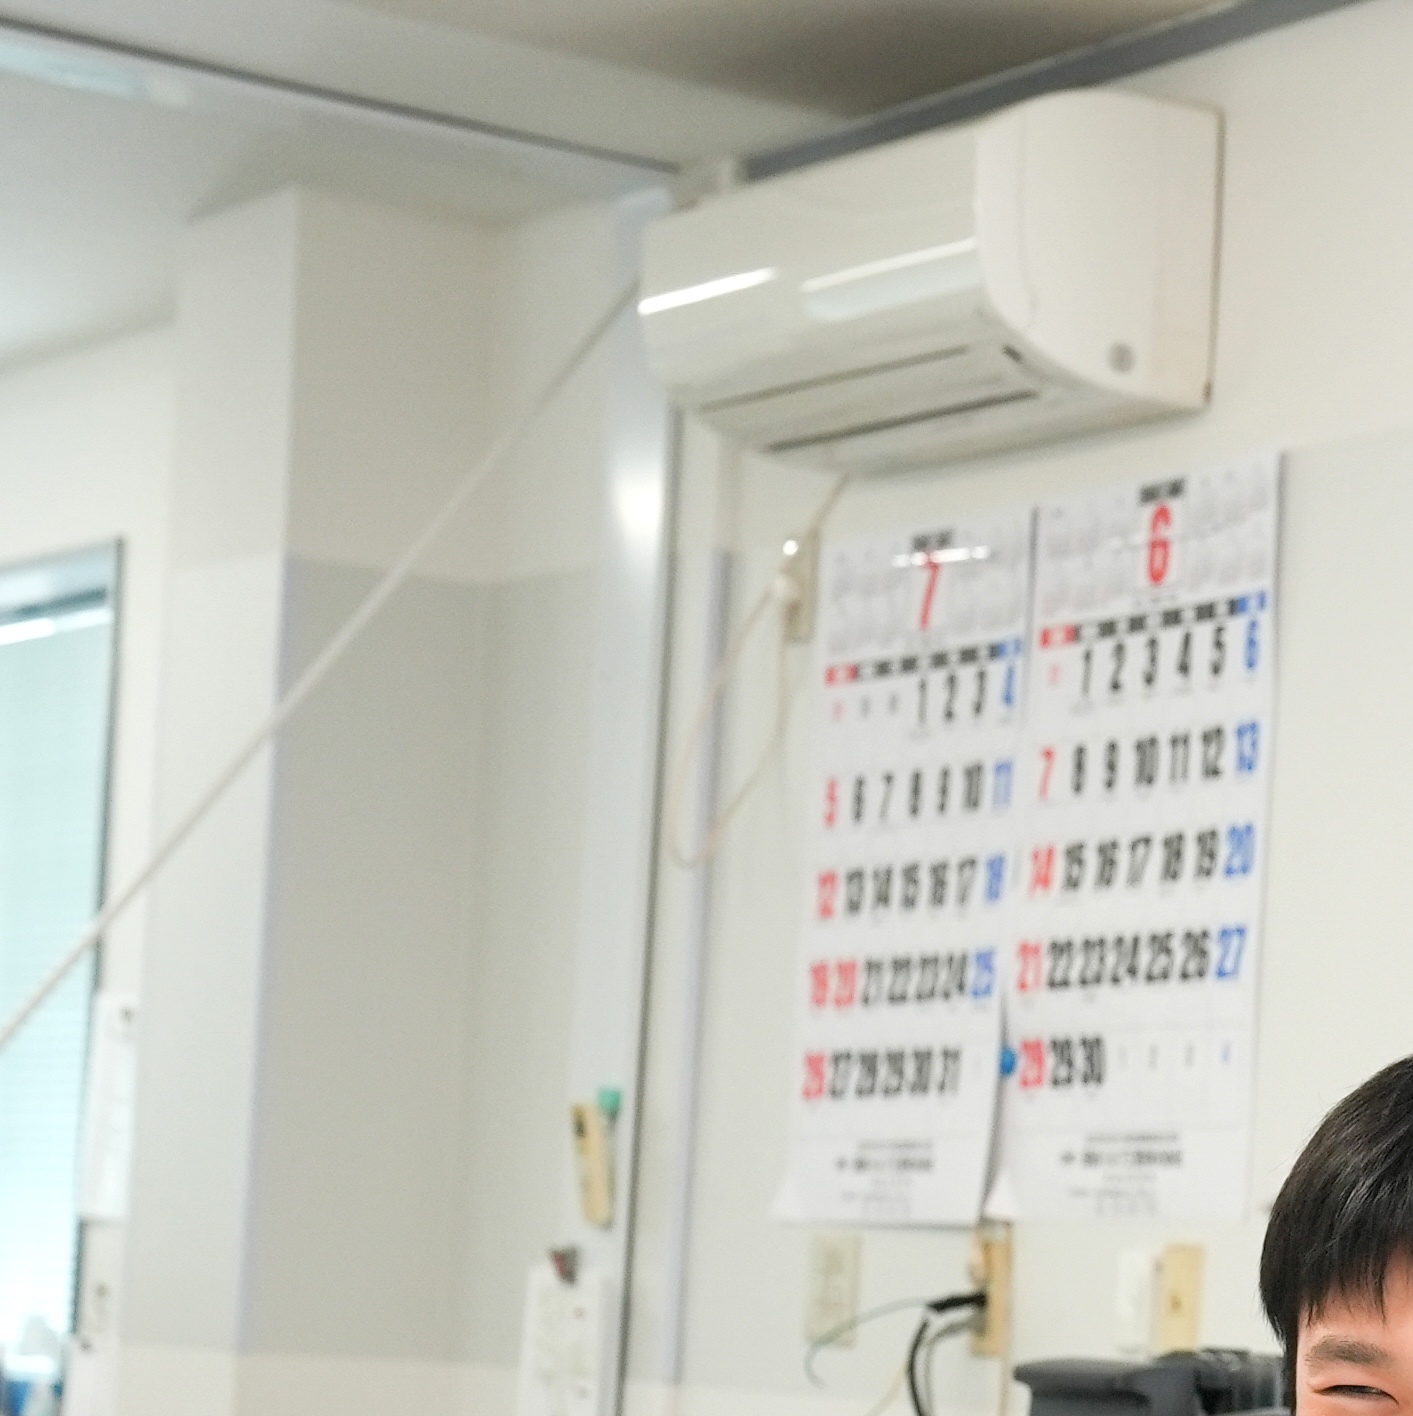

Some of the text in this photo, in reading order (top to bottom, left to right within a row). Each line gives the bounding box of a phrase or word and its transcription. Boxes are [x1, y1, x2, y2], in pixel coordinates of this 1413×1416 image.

[1147, 503, 1172, 584] 6
[918, 553, 941, 632] 7
[1081, 650, 1093, 697] 1
[1109, 642, 1125, 693] 2
[1208, 625, 1226, 677] 5
[1242, 618, 1259, 670] 6
[1038, 745, 1056, 799] 7
[1134, 734, 1158, 786] 10
[1169, 732, 1189, 782] 11
[1201, 726, 1225, 779] 12
[1236, 720, 1259, 773] 13
[1127, 836, 1152, 888] 17
[1047, 938, 1075, 990] 22
[1110, 933, 1140, 986] 24
[1145, 928, 1174, 983] 25
[1215, 924, 1246, 980] 27
